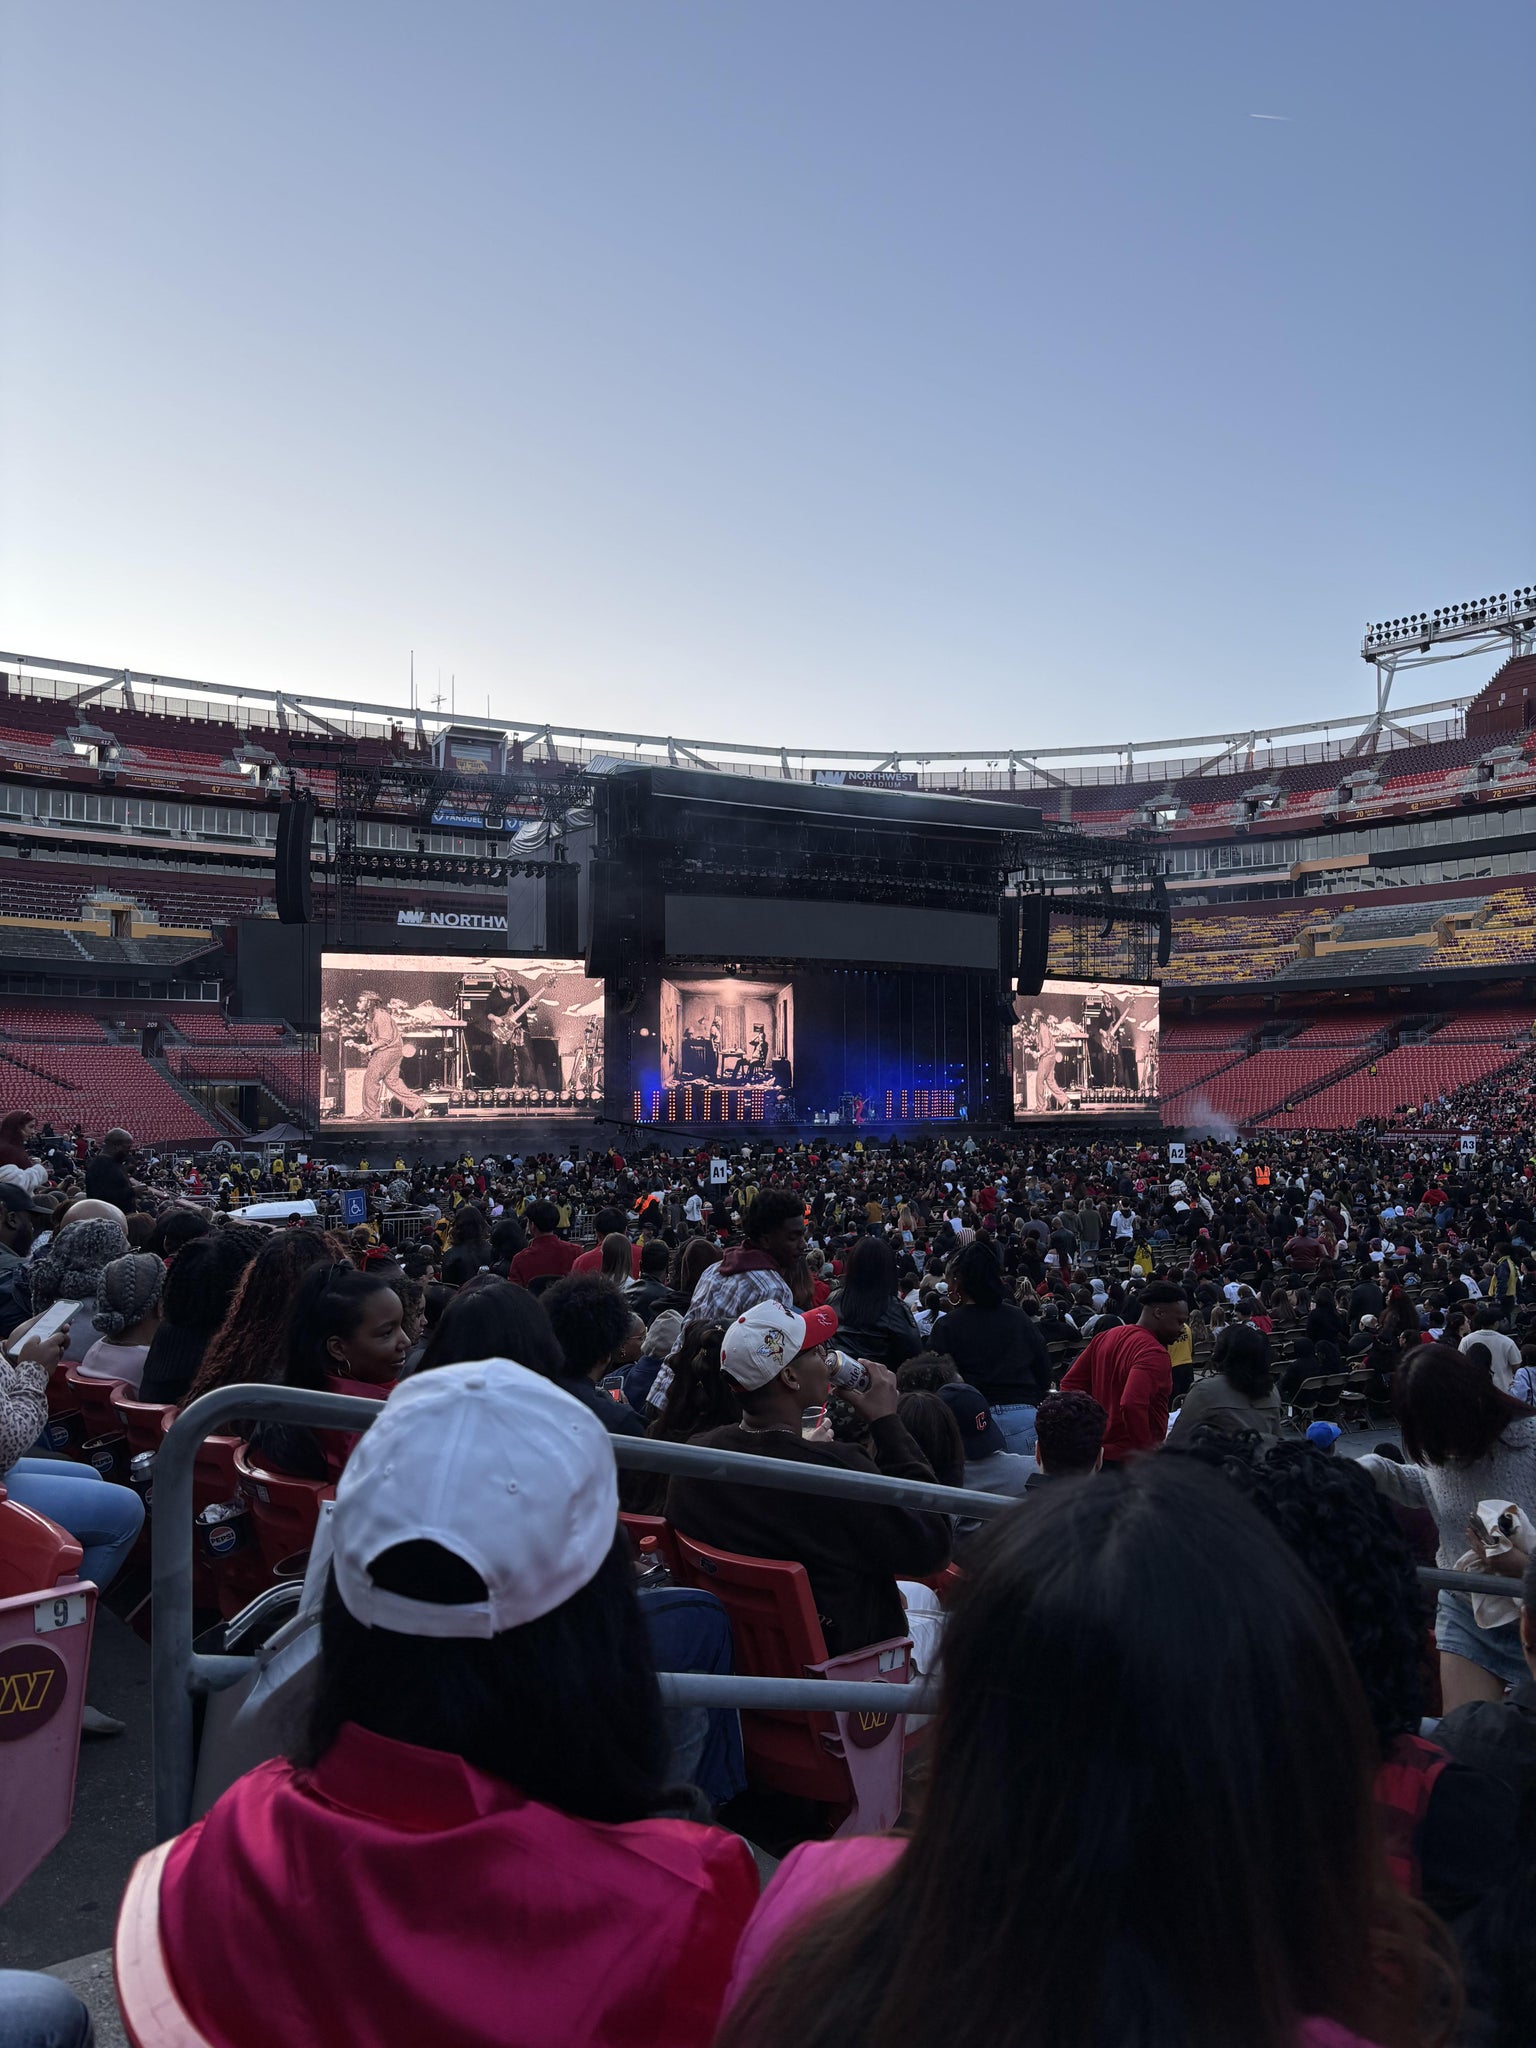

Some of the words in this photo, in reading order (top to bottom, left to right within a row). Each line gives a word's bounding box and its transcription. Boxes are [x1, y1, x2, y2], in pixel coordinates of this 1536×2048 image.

[13, 761, 24, 771] 40
[848, 772, 915, 781] NORTHWEST
[211, 785, 220, 793] 47
[862, 780, 901, 788] STADIUM
[1492, 790, 1502, 798] 72
[1462, 1140, 1475, 1150] A3
[1170, 1148, 1184, 1159] A2
[712, 1166, 725, 1178] A1
[975, 1411, 987, 1431] C
[210, 1532, 234, 1544] PEPSI
[53, 1599, 69, 1627] 9
